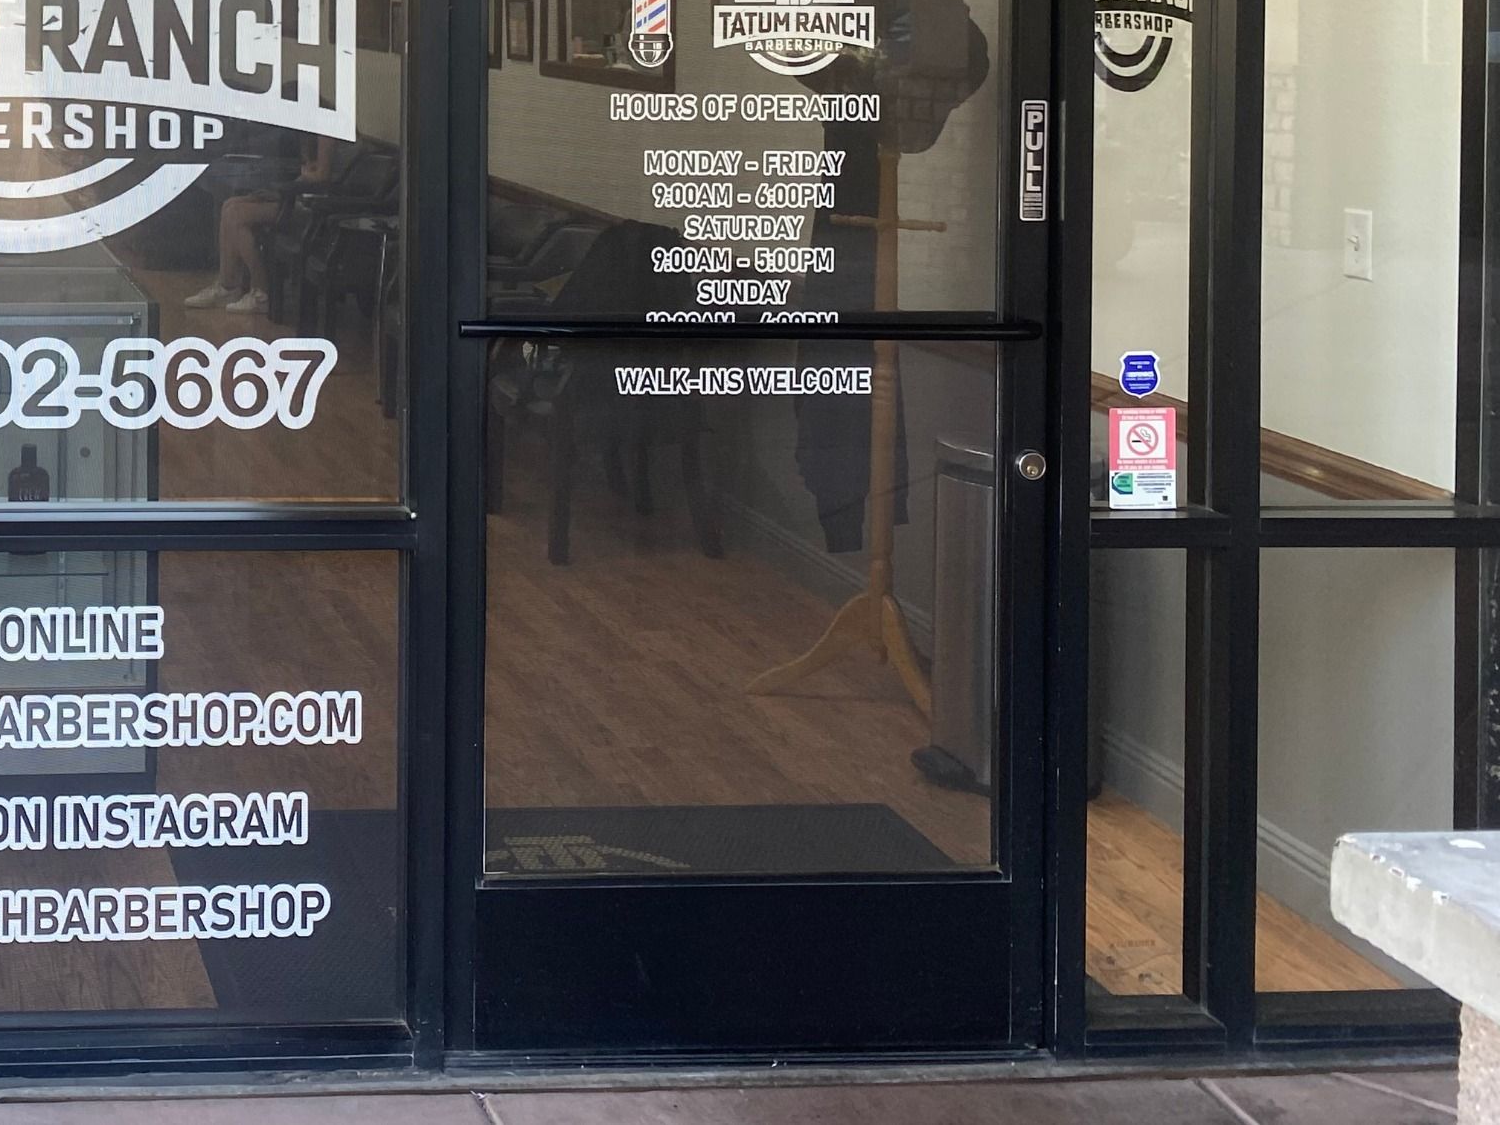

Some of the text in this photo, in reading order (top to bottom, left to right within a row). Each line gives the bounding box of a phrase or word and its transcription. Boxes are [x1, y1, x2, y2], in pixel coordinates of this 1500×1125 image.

[718, 11, 870, 42] TATUM RANCH
[744, 39, 844, 51] BARBERSHOP
[610, 94, 880, 121] HOURS OF OPERATION
[644, 151, 742, 175] MONDAY
[763, 151, 845, 176] FRIDAY
[1025, 111, 1044, 192] PULL
[652, 183, 732, 208] 9:00AM
[755, 183, 835, 208] 6:00PM
[684, 215, 804, 240] SATURDAY
[651, 247, 732, 273] 9:00AM
[754, 247, 835, 273] 5:00PM
[697, 279, 791, 305] SUNDAY
[615, 367, 873, 395] WALK-INS WELCOME
[56, 794, 305, 847] INSTAGRAM
